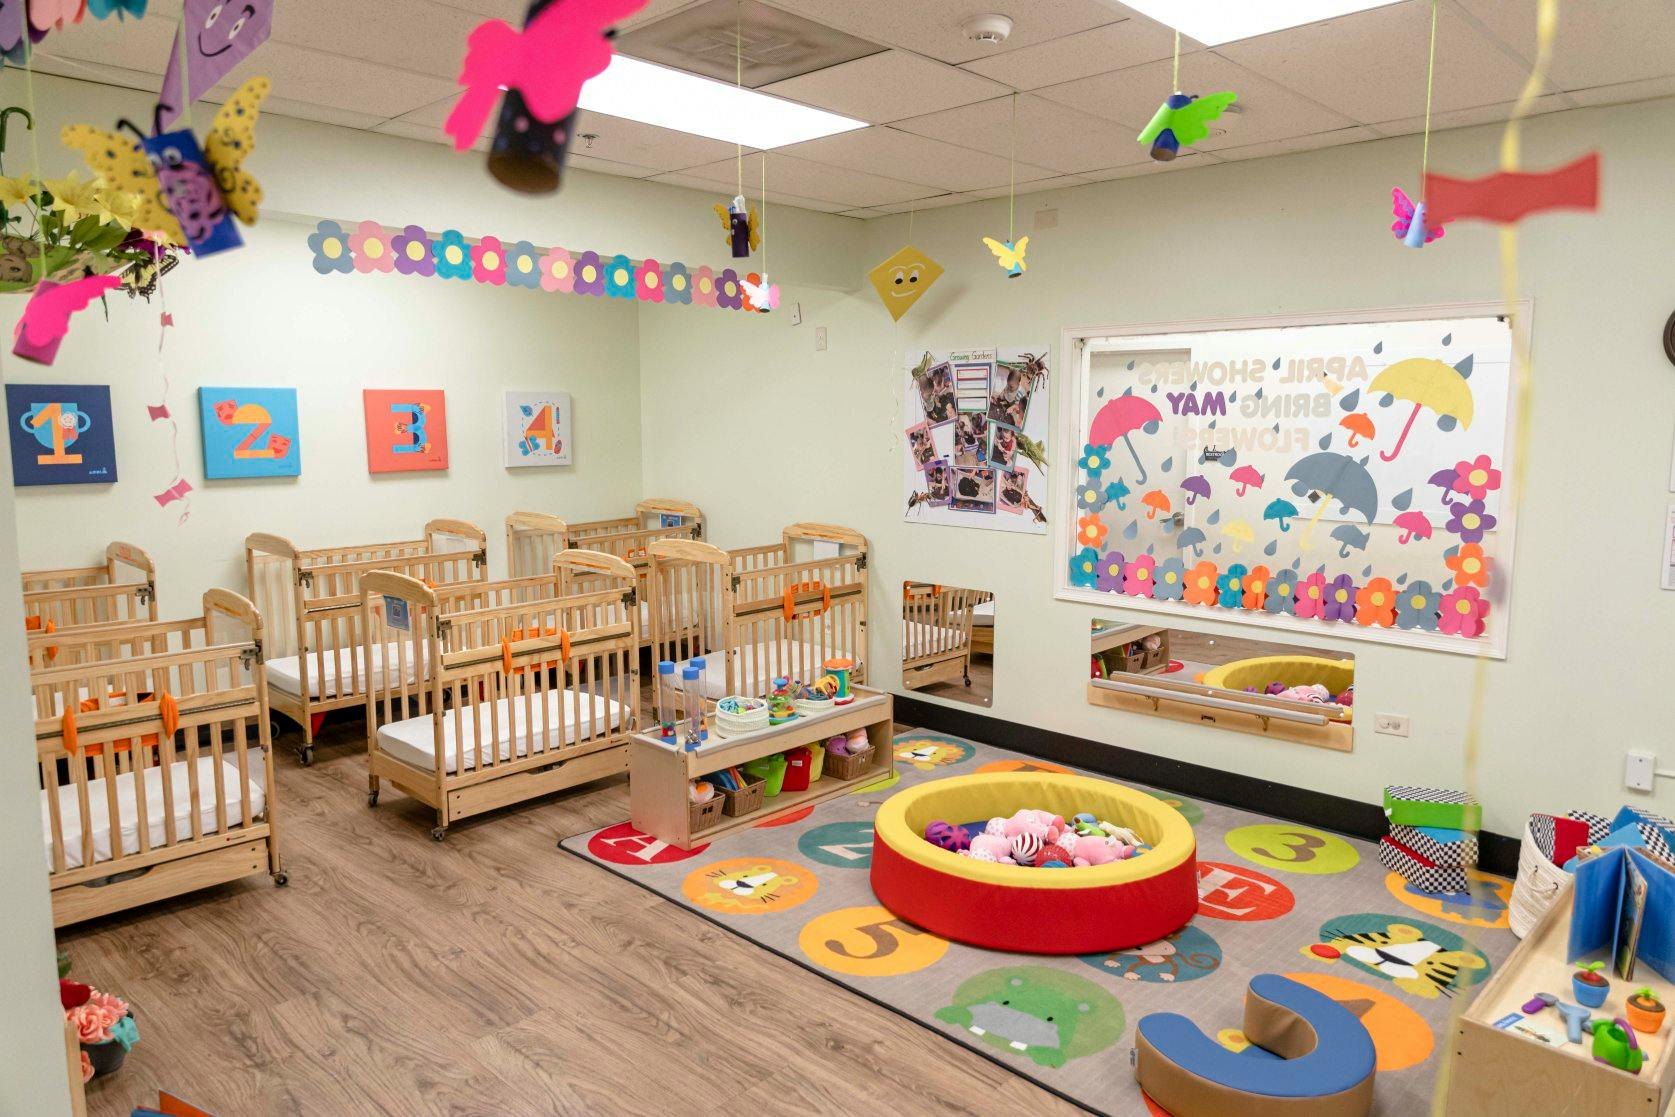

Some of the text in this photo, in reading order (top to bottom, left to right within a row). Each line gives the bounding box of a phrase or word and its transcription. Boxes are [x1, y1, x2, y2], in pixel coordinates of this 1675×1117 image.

[30, 402, 83, 464] 1
[231, 402, 276, 460] 2
[390, 402, 428, 454] 3
[525, 404, 556, 451] 4
[1251, 832, 1326, 863] 3
[1198, 864, 1278, 917] E
[824, 917, 926, 960] 5
